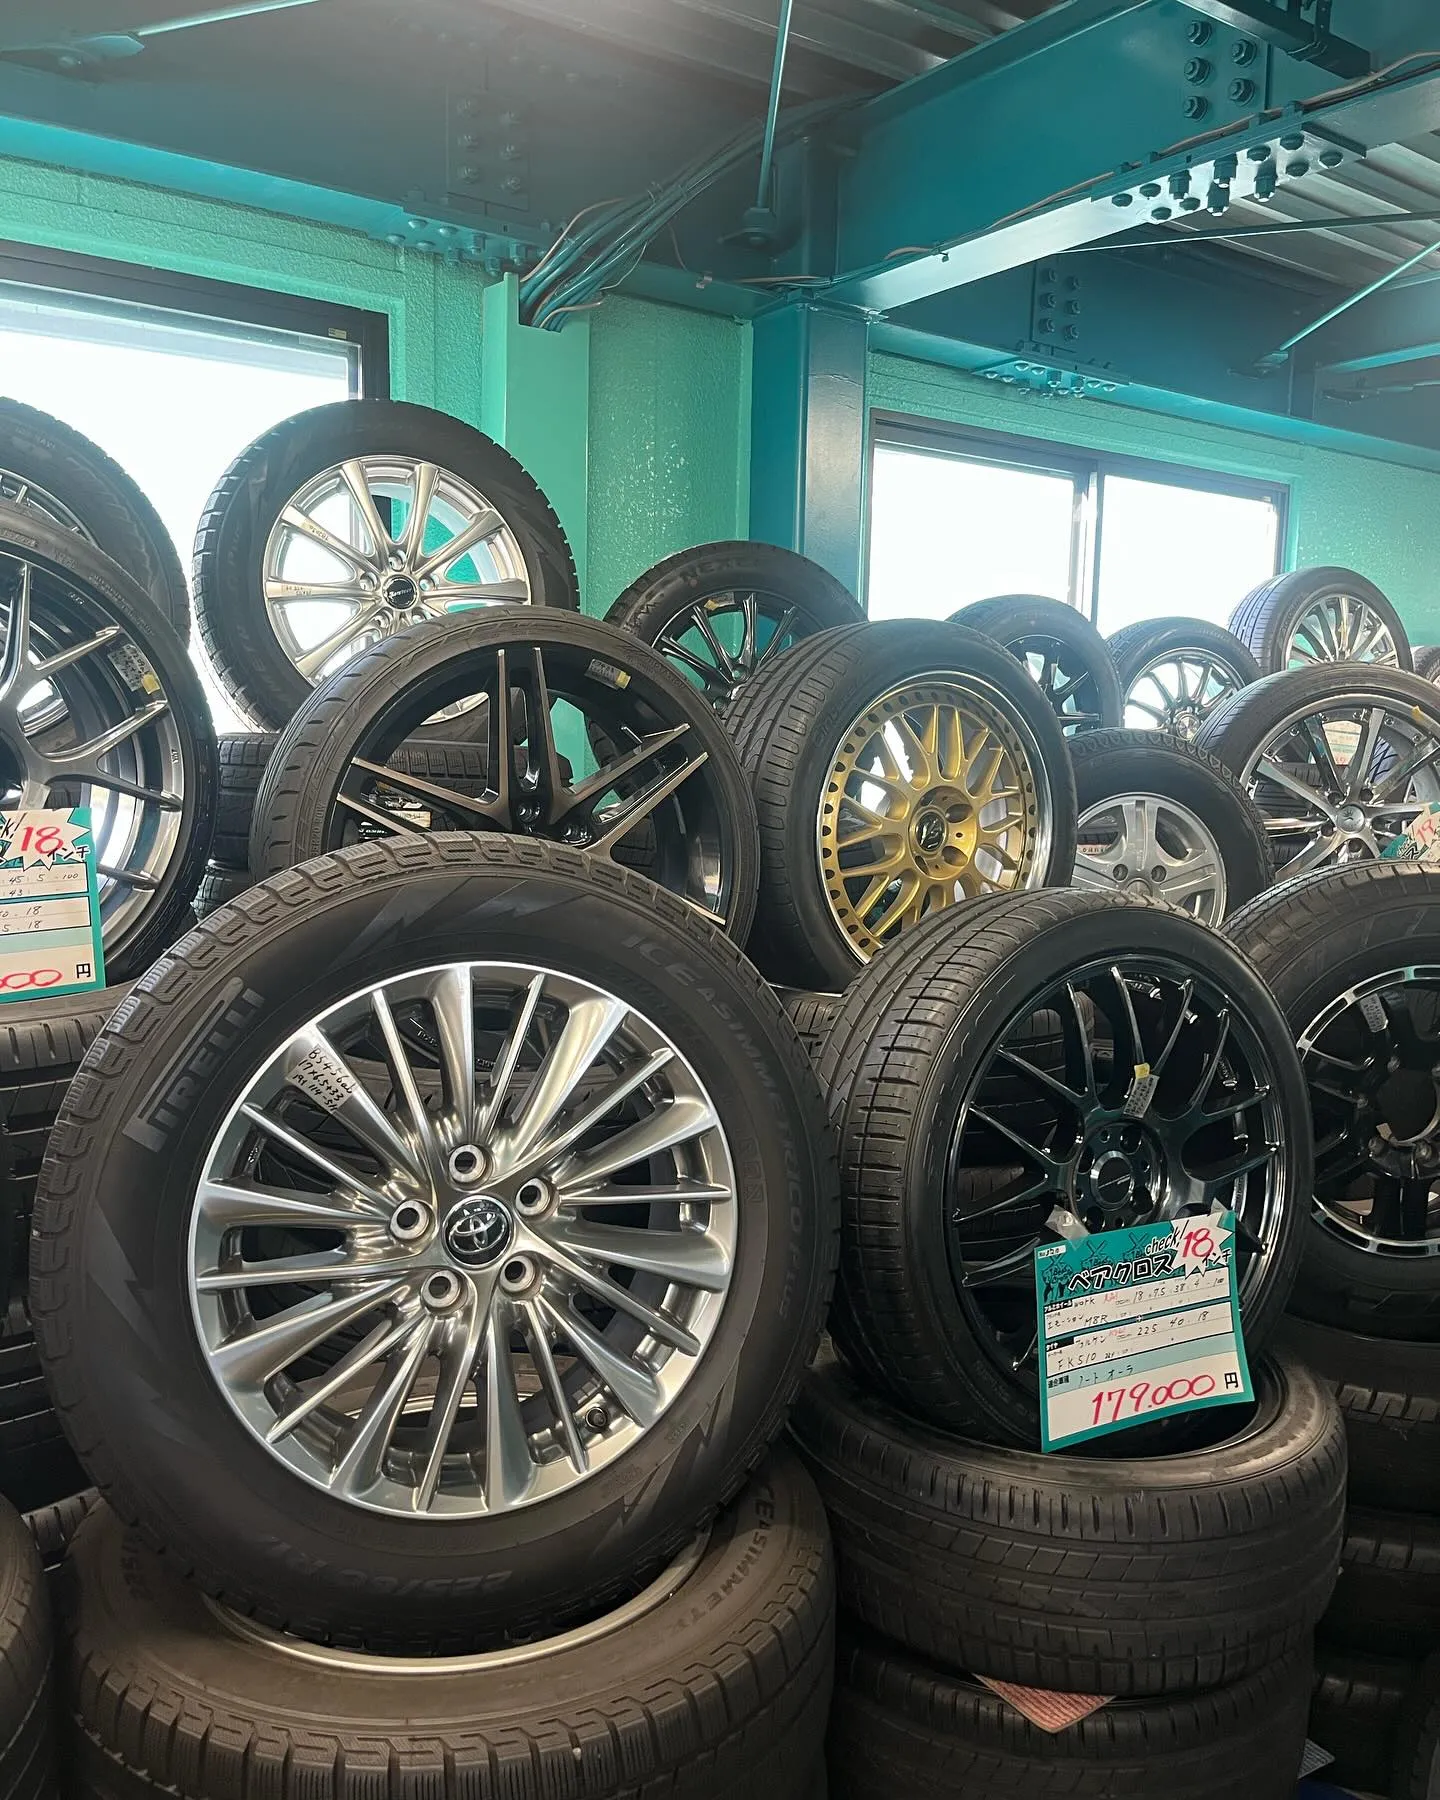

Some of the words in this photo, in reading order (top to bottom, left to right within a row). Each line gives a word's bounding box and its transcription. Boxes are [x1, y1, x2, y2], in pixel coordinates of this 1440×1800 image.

[0, 812, 27, 839] k!
[1416, 818, 1434, 843] 19
[21, 825, 64, 855] 18
[48, 845, 90, 862] インチ
[9, 875, 25, 885] 45
[37, 873, 46, 882] 5
[63, 872, 79, 880] 100
[9, 889, 23, 897] 43
[26, 905, 41, 915] 18
[28, 920, 42, 929] 18
[621, 932, 698, 987] ICE
[0, 969, 63, 990] 00
[76, 962, 91, 979] 円
[122, 976, 265, 1152] PIRELLI
[1144, 1219, 1190, 1256] check!
[1182, 1227, 1214, 1258] 18
[1202, 1249, 1232, 1266] インチ
[1068, 1252, 1175, 1292] ベアクロス
[1133, 1290, 1144, 1304] 18
[1137, 1323, 1158, 1336] 225
[1169, 1317, 1184, 1328] 40
[1198, 1311, 1209, 1321] 18
[1223, 1371, 1240, 1390] 円
